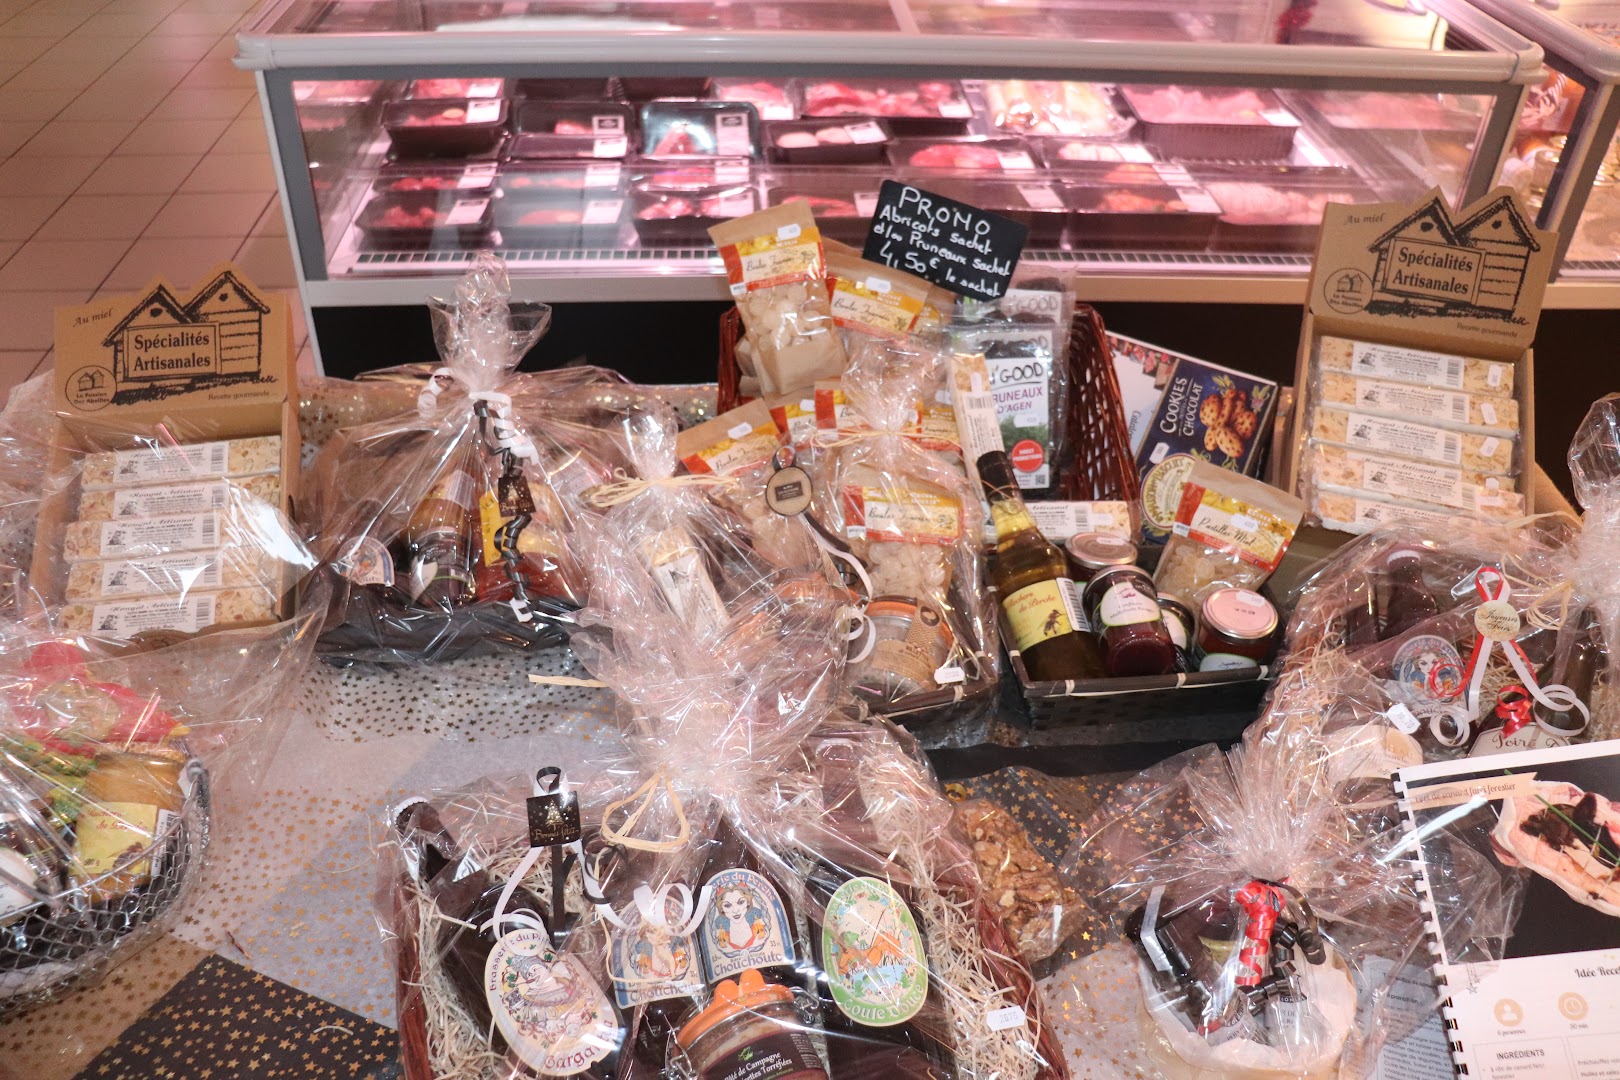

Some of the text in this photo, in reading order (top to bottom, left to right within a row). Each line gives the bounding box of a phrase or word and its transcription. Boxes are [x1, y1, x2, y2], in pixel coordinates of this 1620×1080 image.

[899, 186, 990, 235] PROMO
[1344, 212, 1384, 225] Au miel
[879, 205, 992, 255] Abricots sachet
[910, 232, 966, 265] Pruneaux
[972, 258, 1011, 276] sachet
[1398, 247, 1473, 272] Spécialités
[946, 268, 956, 282] le
[961, 278, 1000, 296] sachet
[1392, 269, 1470, 294] Artisanales
[72, 308, 112, 328] Au miel
[134, 331, 210, 352] Spécialités
[134, 353, 210, 372] Artisanales
[992, 387, 1043, 403] RUNEAUX
[1160, 376, 1186, 434] COOKIES
[997, 402, 1032, 414] D'AGEN
[1184, 382, 1203, 437] CHOCOLAT
[1200, 518, 1256, 546] Pastilles Miel
[1479, 610, 1518, 622] Joyeuses
[1488, 783, 1516, 796] forestier
[732, 871, 746, 881] du
[748, 872, 776, 902] Perche
[516, 934, 529, 942] du
[1575, 967, 1596, 979] Idée
[843, 998, 886, 1020] Coule
[746, 1052, 781, 1071] Campagne
[1496, 1048, 1544, 1060] INGRÉDIENTS
[760, 1058, 792, 1075] Torréfiées
